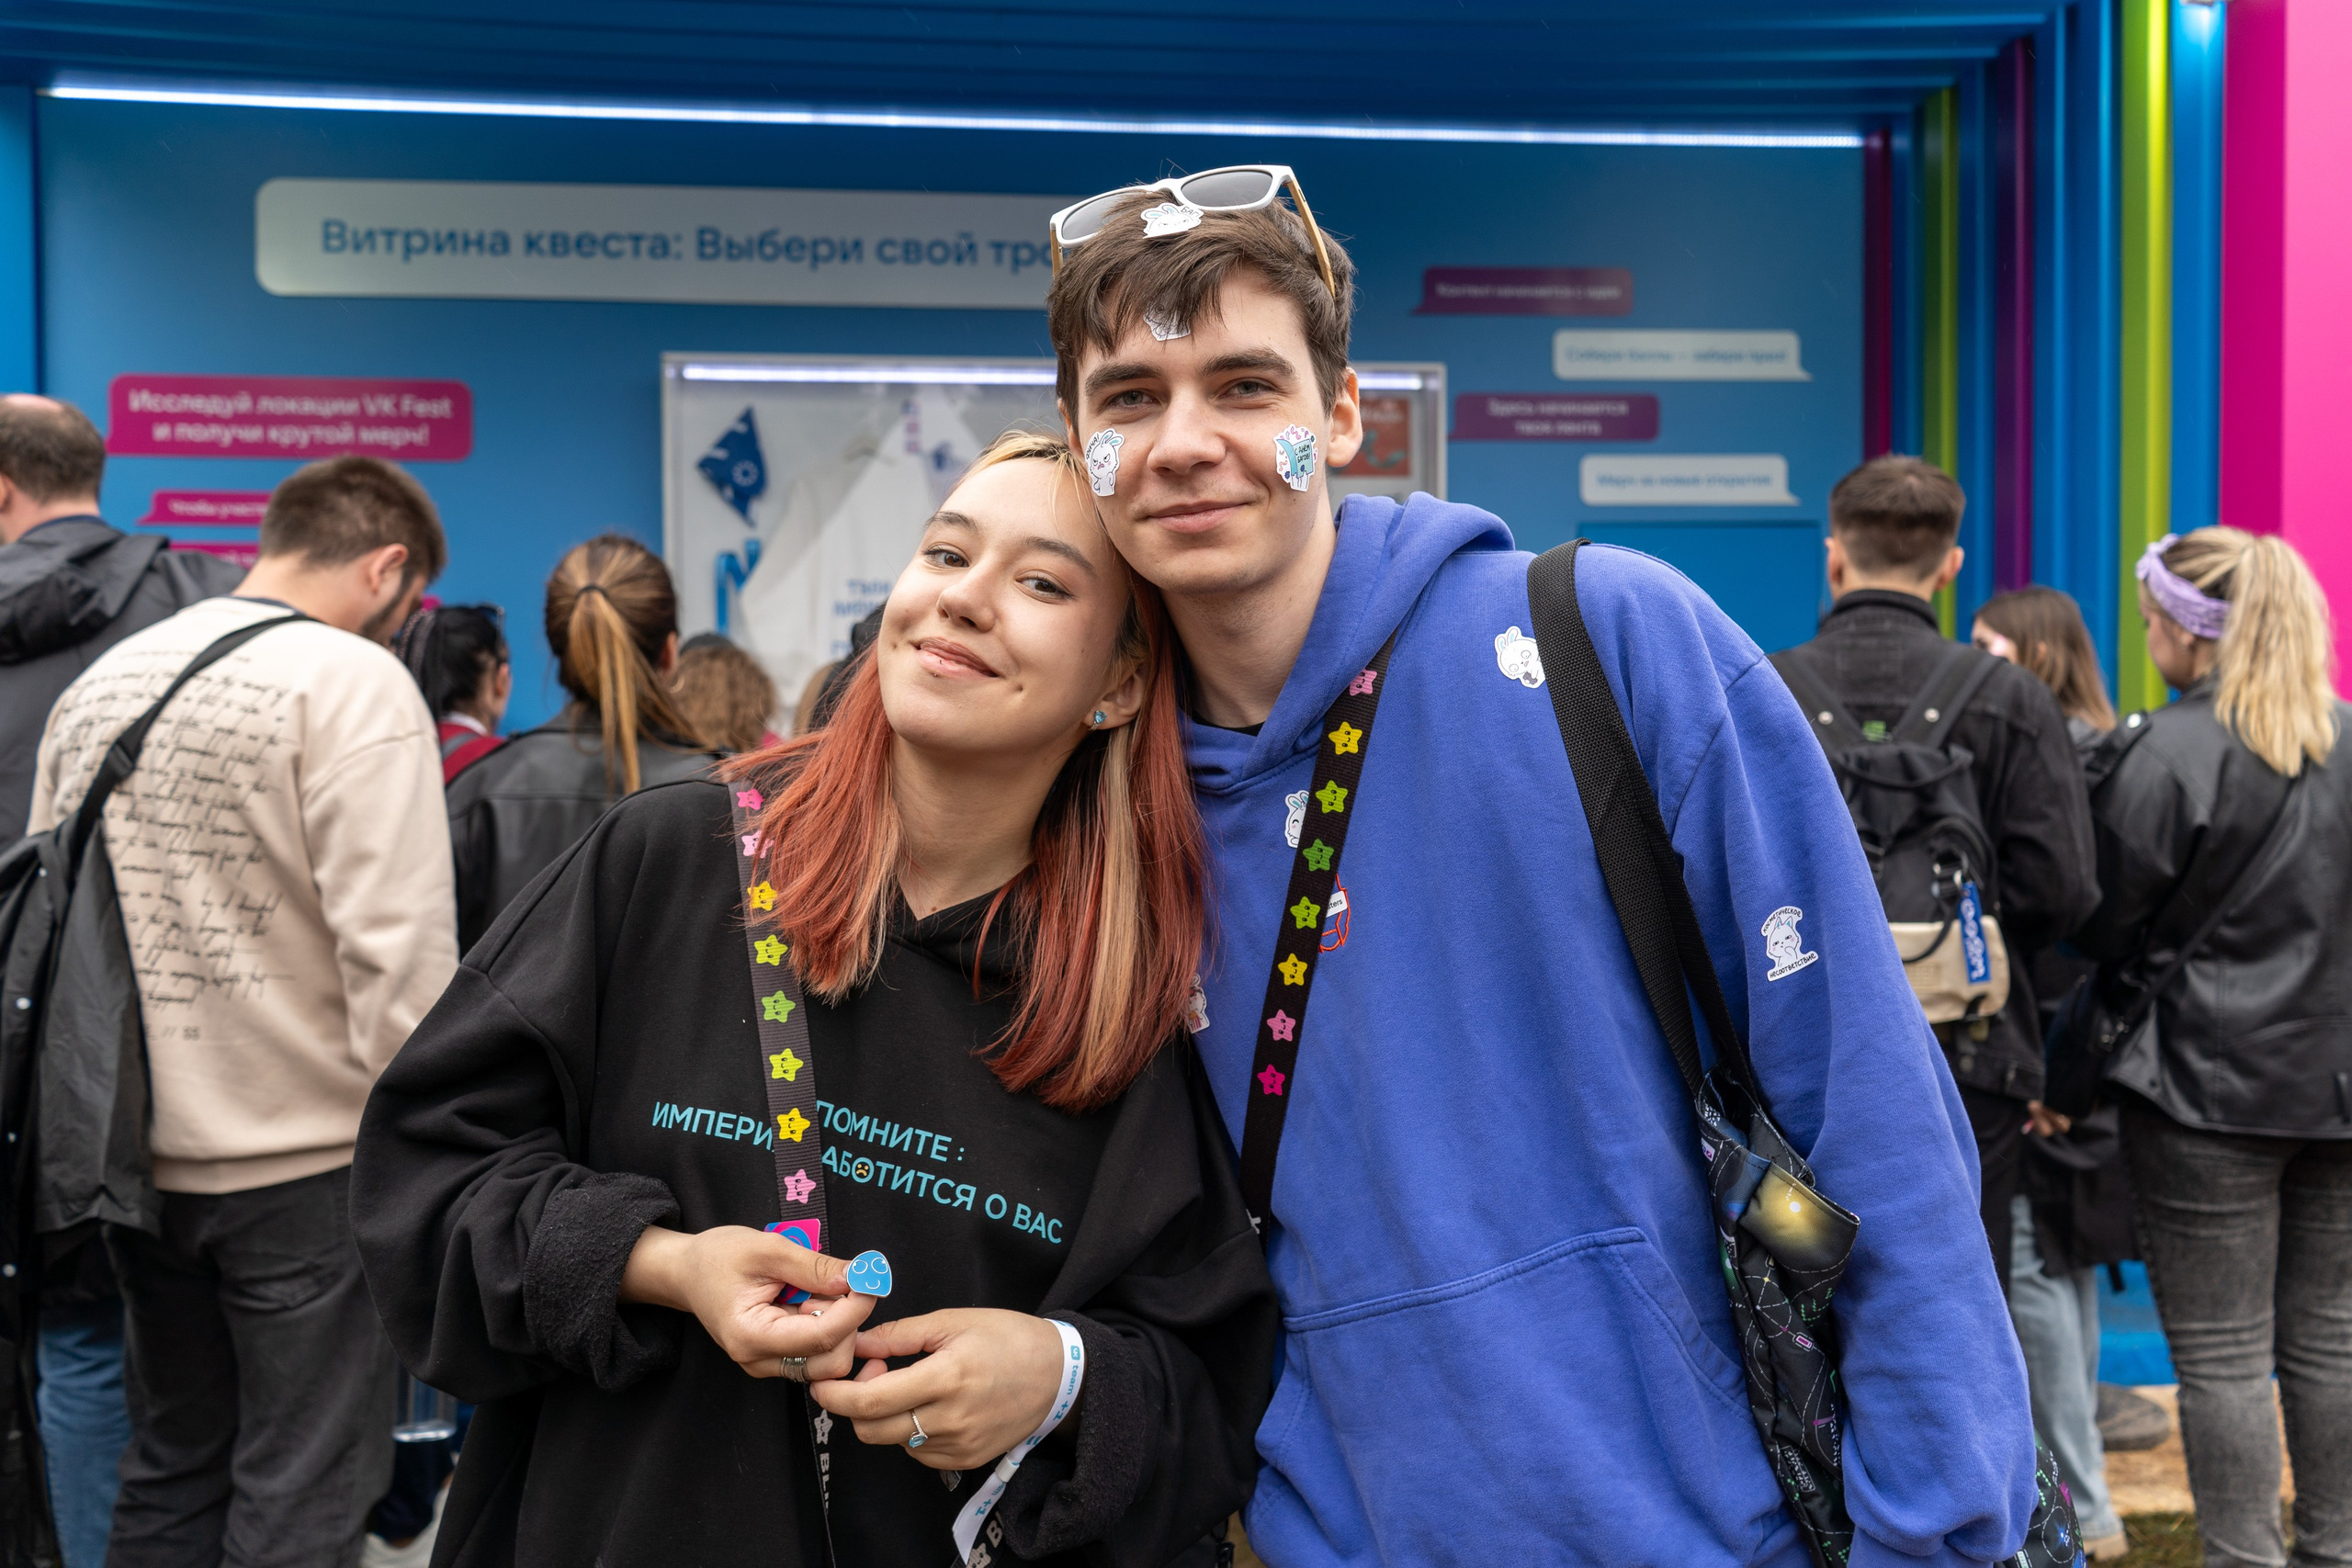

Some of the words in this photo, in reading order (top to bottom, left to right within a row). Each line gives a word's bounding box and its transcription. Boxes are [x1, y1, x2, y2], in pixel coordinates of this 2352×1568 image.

[321, 218, 510, 265] Витрина
[523, 229, 683, 262] квеста:
[695, 225, 865, 270] Выбери
[874, 230, 978, 267] свой
[129, 389, 254, 418] Исследуй
[256, 395, 359, 419] локации
[362, 395, 398, 417] VK
[401, 396, 455, 419] Fest
[153, 423, 172, 442] и
[175, 423, 265, 447] получи
[266, 422, 356, 448] крутой
[358, 423, 431, 449] мерч!
[1327, 898, 1343, 910] sters
[651, 1101, 775, 1152] ИМПЕРИ
[821, 1145, 977, 1211] АБОТИТСЯ
[984, 1193, 1008, 1220] О
[1012, 1202, 1063, 1244] ВАС
[1067, 1364, 1080, 1395] team
[1053, 1400, 1069, 1422] +1
